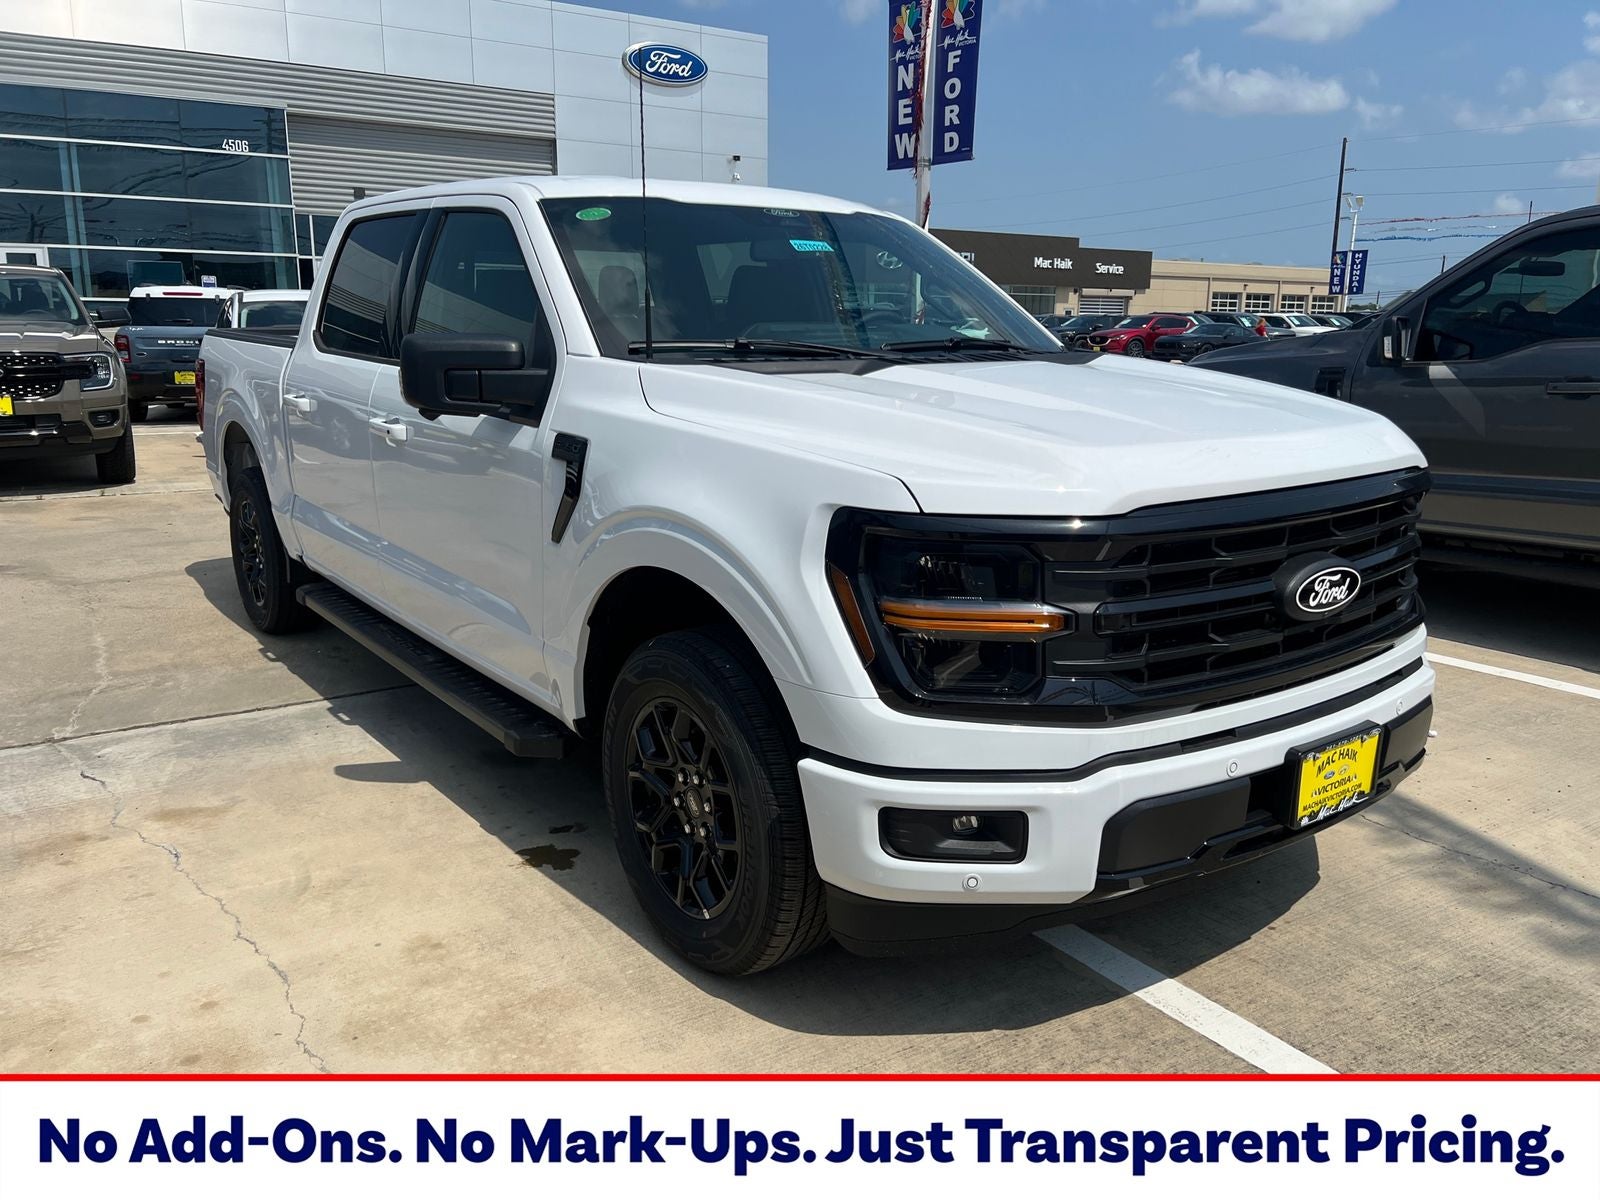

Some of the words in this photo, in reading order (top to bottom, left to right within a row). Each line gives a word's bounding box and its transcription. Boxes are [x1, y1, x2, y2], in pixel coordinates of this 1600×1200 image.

[645, 50, 693, 77] Ford
[894, 63, 917, 159] NEW
[944, 50, 962, 153] FORD
[222, 138, 249, 153] 4506
[1034, 257, 1052, 269] Mac
[1053, 258, 1073, 270] Haik
[1095, 262, 1124, 275] Service
[1351, 252, 1363, 293] HYUNDAI
[1331, 268, 1341, 293] NEW
[1309, 573, 1351, 607] Ford
[1316, 752, 1337, 777] MAC
[1338, 748, 1358, 762] HAIK
[1302, 783, 1362, 812] MACHAIKVICTORIA.COM
[1317, 775, 1351, 795] VICTORIA
